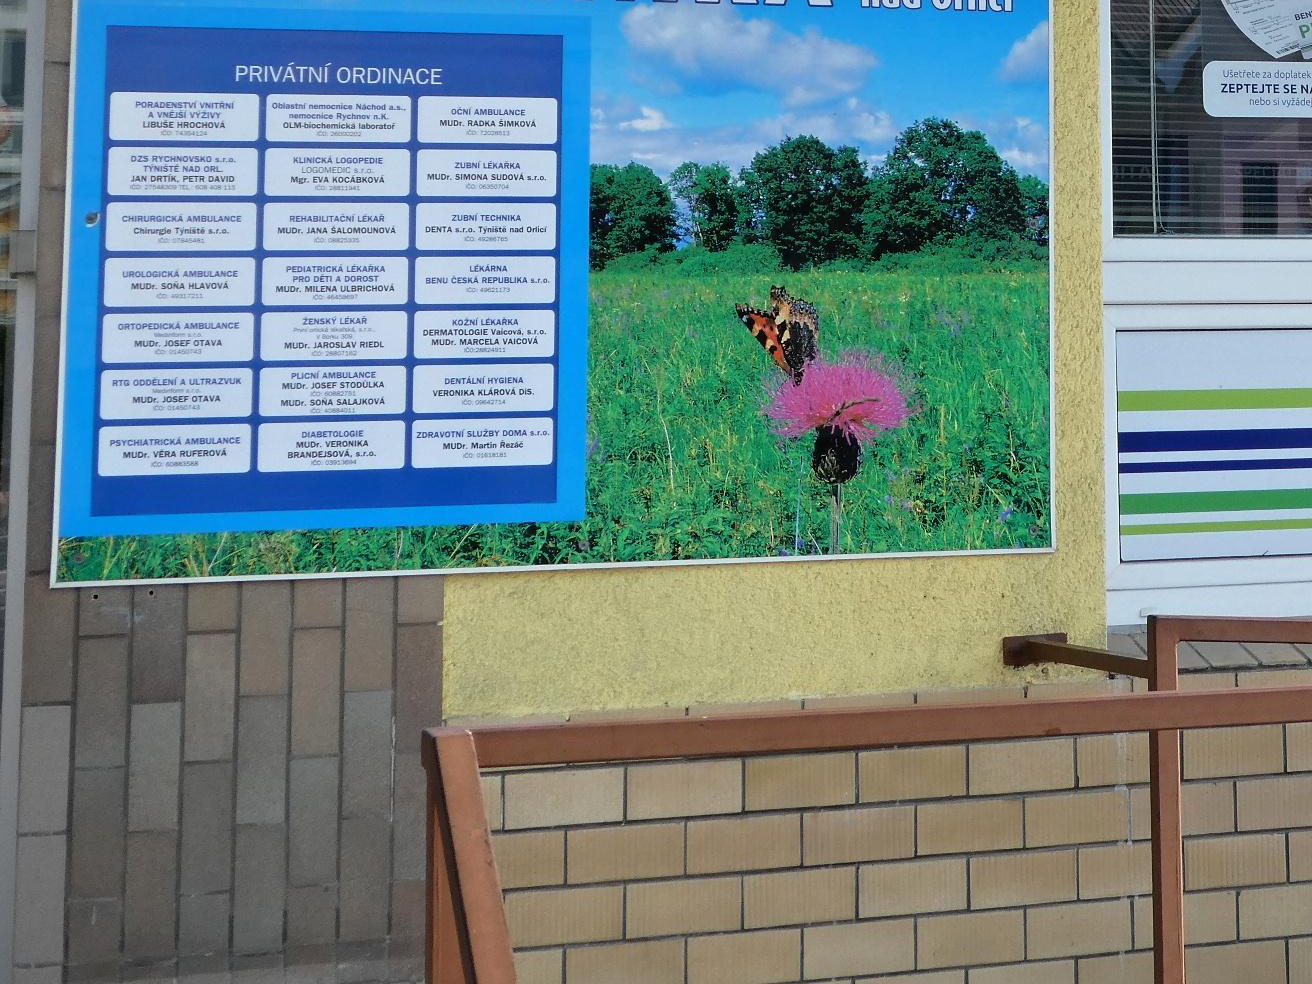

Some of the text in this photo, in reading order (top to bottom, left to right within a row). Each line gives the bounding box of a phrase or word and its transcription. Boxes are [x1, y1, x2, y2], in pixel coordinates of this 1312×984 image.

[236, 62, 442, 84] PRIVÁTNÍ ORDINACE
[1222, 69, 1260, 79] Ušetřete
[1274, 69, 1311, 80] doplatek
[1220, 83, 1279, 94] ZEPTEJTE
[1283, 83, 1297, 94] SE
[1249, 96, 1270, 105] nebo
[451, 106, 471, 116] OČNÍ
[498, 118, 536, 128] ŠIMKOVÁ
[293, 155, 332, 164] KLINICKÁ
[454, 160, 520, 169] ZUBNÍ LÉKAŘKA
[290, 176, 309, 185] Mgr.
[332, 174, 384, 184] KOCÁBKOVÁ
[121, 214, 183, 223] CHIRURGICKÁ
[289, 213, 384, 223] REHABILITAČNÍ LÉKAŘ
[330, 225, 396, 234] ŠALOMOUNOVÁ
[478, 225, 506, 234] Týniště
[286, 263, 385, 273] PEDIATRICKÁ LÉKAŘKA
[469, 264, 507, 272] LÉKÁRNA
[122, 270, 179, 278] UROLOGICKÁ
[313, 274, 332, 283] DĚTI
[450, 275, 478, 284] ČESKÁ
[160, 280, 185, 290] SOŇA
[188, 280, 228, 290] HLAVOVÁ
[340, 283, 394, 292] ULBRICHOVÁ
[302, 315, 367, 326] ŽENSKÝ LÉKAŘ
[452, 317, 518, 326] KOŽNÍ LÉKAŘKA
[117, 321, 239, 331] ORTOPEDICKÁ AMBULANCE
[313, 341, 356, 349] JAROSLAV
[502, 336, 538, 345] VAICOVÁ
[132, 377, 176, 387] ODDĚLENÍ
[188, 377, 241, 386] ULTRAZVUK
[444, 375, 484, 385] DENTÁLNÍ
[432, 389, 474, 397] VERONIKA
[477, 387, 516, 396] KLÁROVÁ
[416, 429, 464, 438] ZDRAVOTNÍ
[466, 428, 499, 438] SLUŽBY
[109, 436, 240, 447] PSYCHIATRICKÁ AMBULANCE
[470, 441, 497, 449] Martin
[499, 439, 523, 449] Řezáč
[122, 447, 226, 459] MUDr. VĚRA RUFEROVÁ
